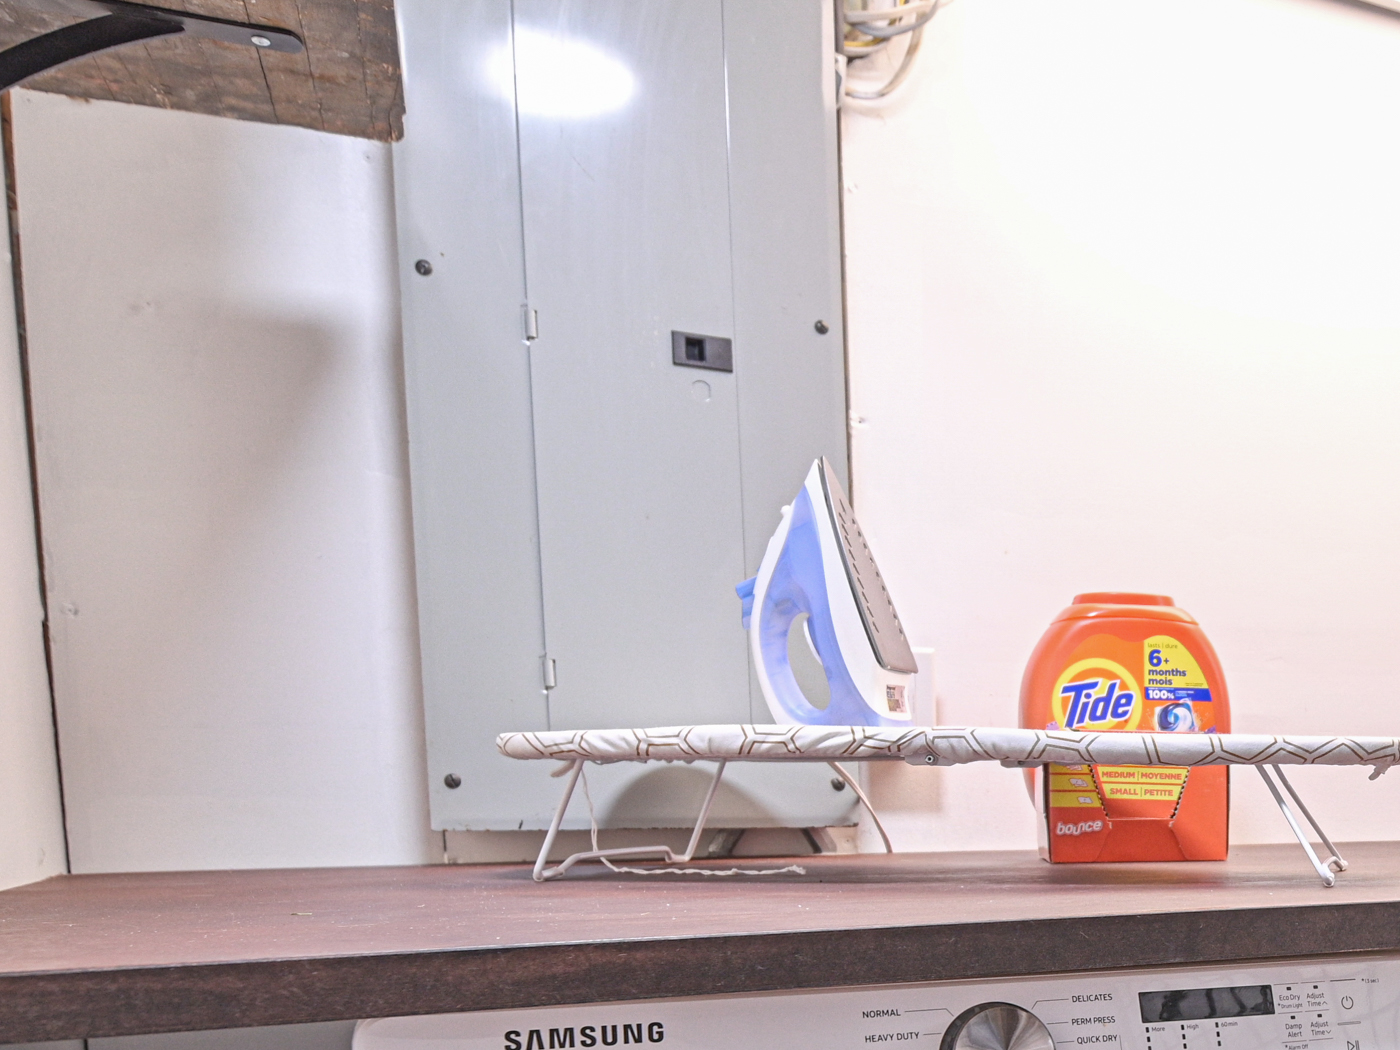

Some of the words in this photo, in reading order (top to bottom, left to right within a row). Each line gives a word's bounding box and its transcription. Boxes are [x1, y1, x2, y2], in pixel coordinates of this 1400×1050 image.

[1148, 668, 1187, 677] months
[1148, 677, 1173, 686] mois
[1148, 690, 1175, 699] 100%
[1060, 679, 1136, 728] Tide
[1101, 771, 1136, 779] MEDIUM
[1140, 772, 1182, 780] MOYENNE
[1144, 788, 1174, 796] PETITE
[1056, 820, 1103, 836] bounce
[1071, 993, 1113, 1003] DELICATES
[1306, 992, 1325, 1000] Adjust
[862, 1008, 902, 1019] NORMAL
[1071, 1017, 1092, 1026] PERM
[1093, 1016, 1116, 1025] PRESS
[1310, 1021, 1329, 1029] Adjust
[865, 1033, 894, 1043] HEAVY
[896, 1031, 920, 1041] DUTY
[1077, 1036, 1101, 1045] QUICK
[1102, 1034, 1118, 1043] DRY
